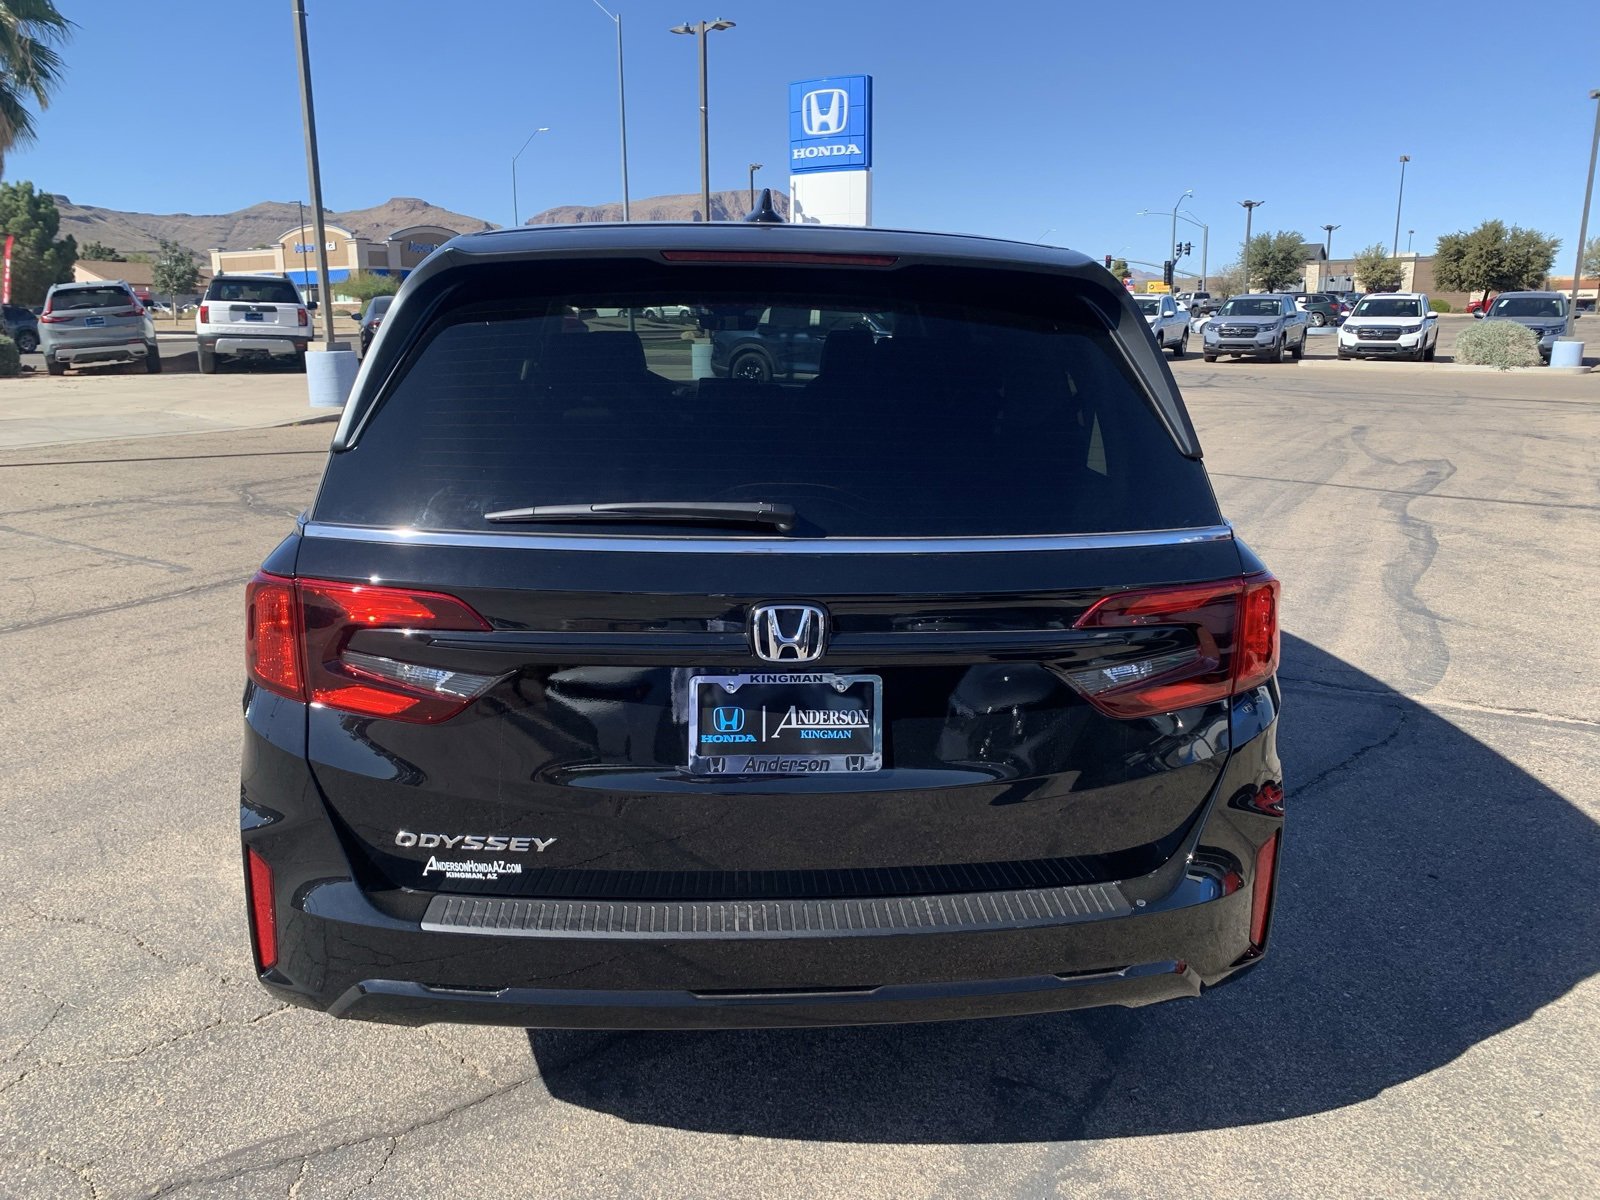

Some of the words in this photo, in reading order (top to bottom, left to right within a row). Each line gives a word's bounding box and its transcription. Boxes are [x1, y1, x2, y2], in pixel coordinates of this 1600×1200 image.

[792, 144, 862, 160] HONDA
[750, 674, 823, 683] KINGMAN
[771, 705, 870, 738] ANDERSON
[701, 734, 757, 743] HONDA
[800, 730, 852, 738] KINGMAN
[743, 756, 830, 772] Anderson
[394, 831, 557, 852] ODYSSEY
